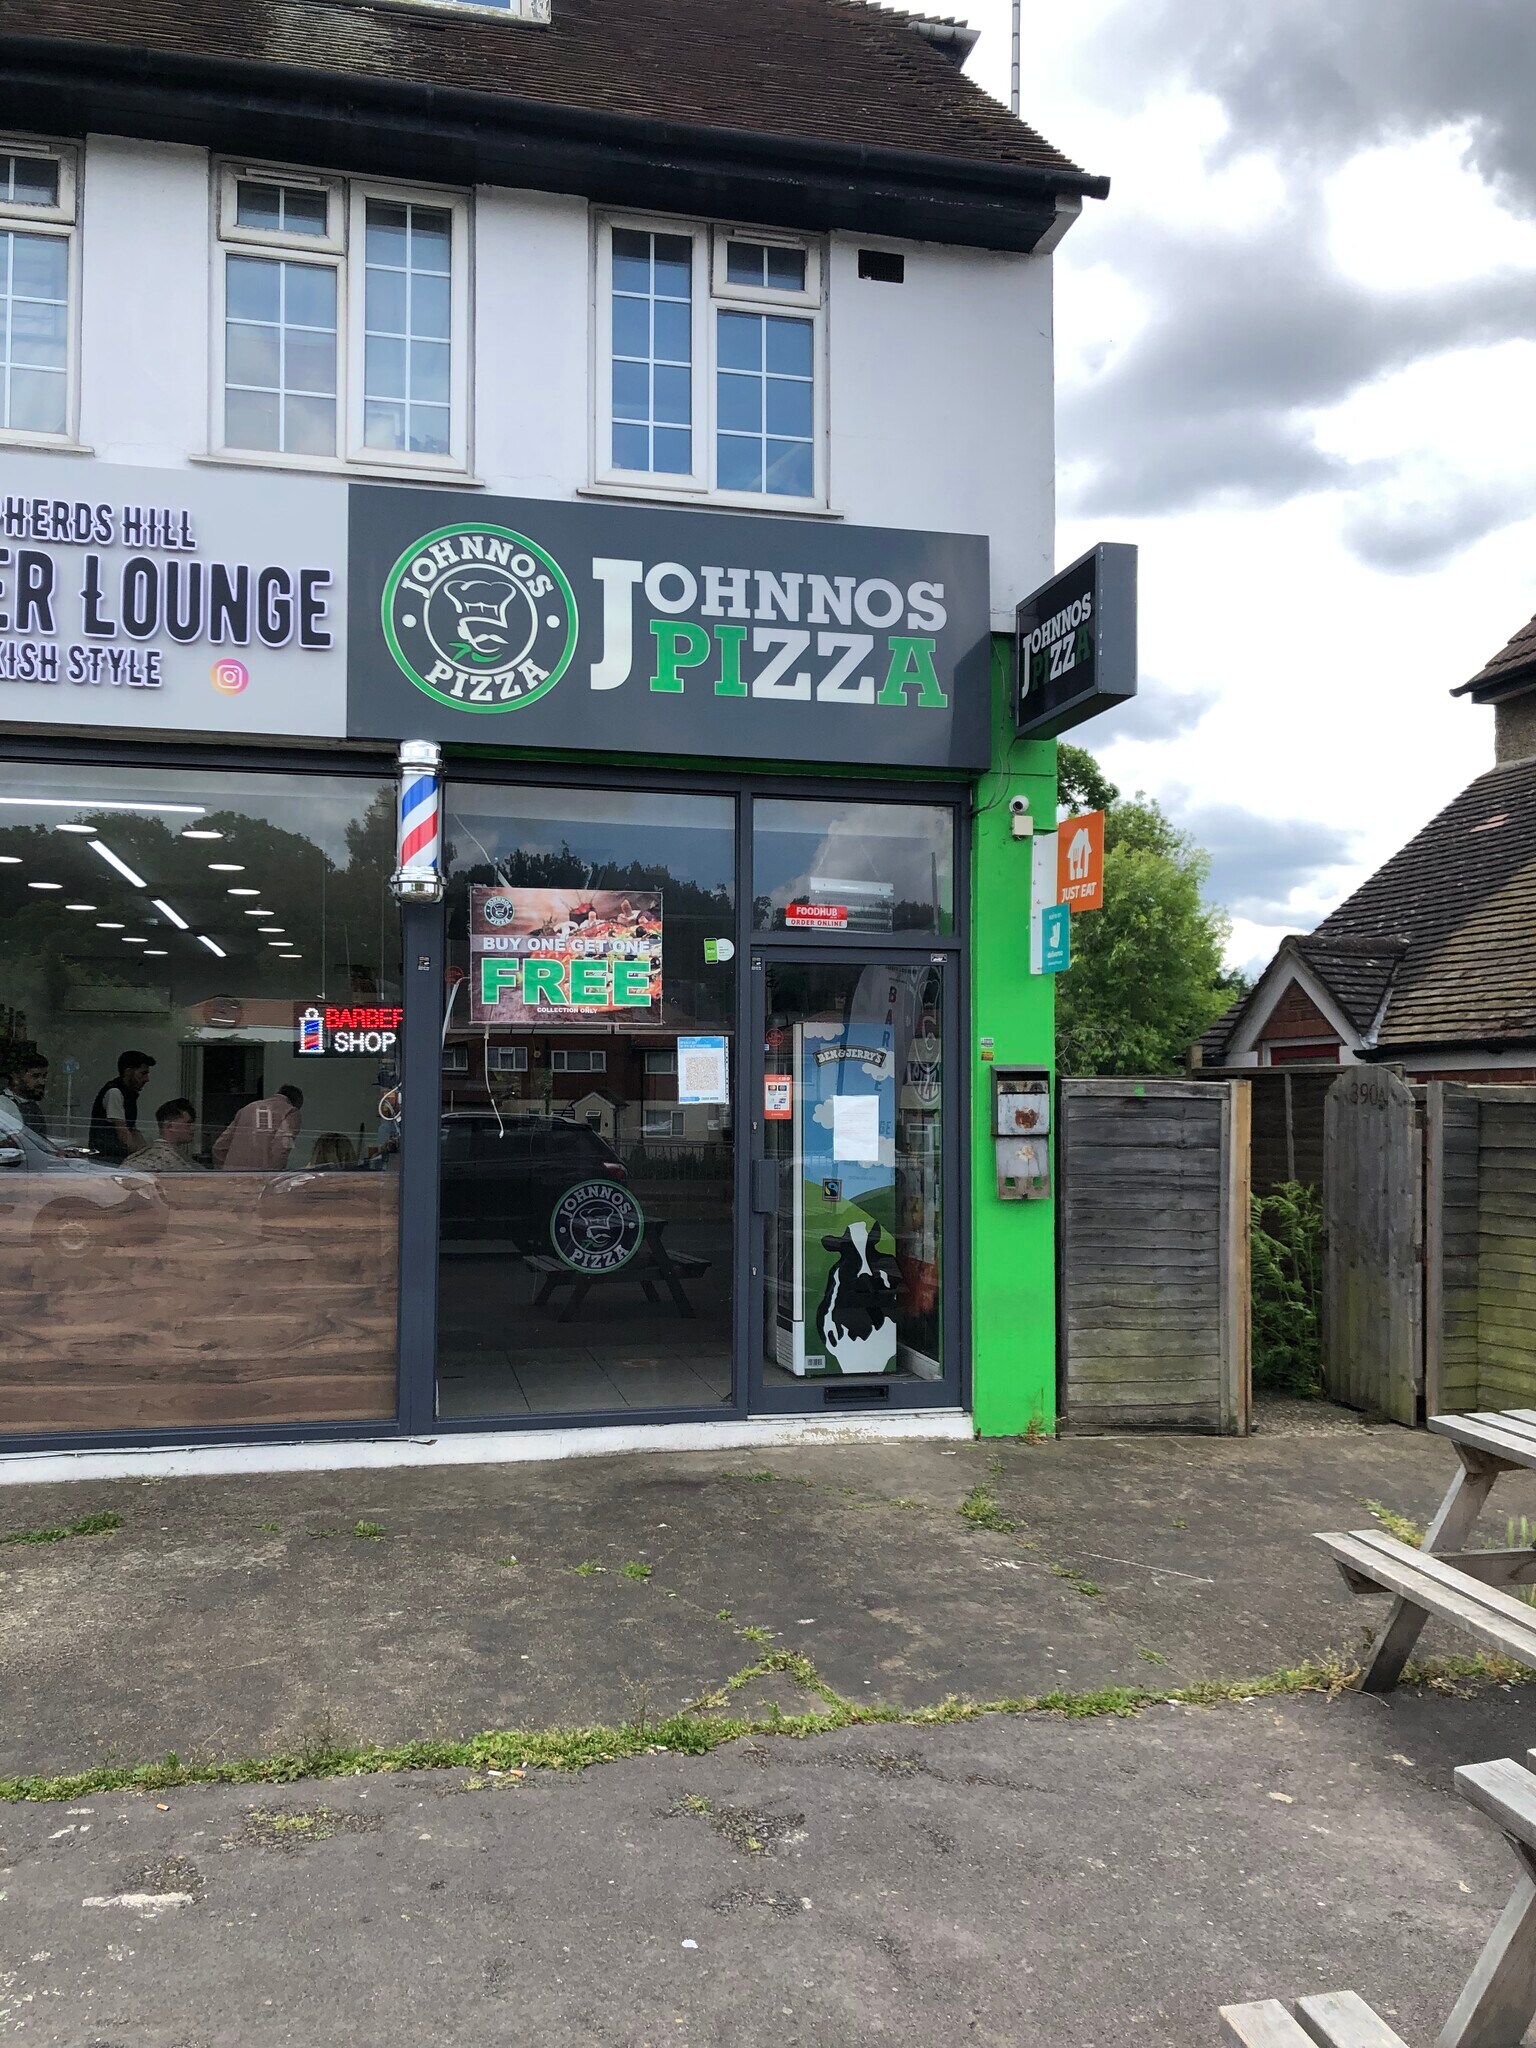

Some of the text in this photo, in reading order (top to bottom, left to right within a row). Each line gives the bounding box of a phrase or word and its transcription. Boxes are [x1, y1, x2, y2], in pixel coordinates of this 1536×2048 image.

[121, 506, 197, 549] HILL
[401, 535, 554, 599] JOHNNOS
[80, 554, 334, 648] LOUNGE
[590, 556, 948, 690] JOHNNOS
[67, 645, 162, 687] STYLE
[649, 618, 949, 708] PIZZA
[1022, 591, 1091, 699] JOHNNOS
[1032, 622, 1090, 692] PIZZA
[424, 658, 550, 701] PIZZA
[796, 906, 838, 916] FOODHUB
[1061, 882, 1097, 903] JUST EAT
[483, 937, 650, 954] BUY ONE GET ONE
[481, 957, 652, 1007] FREE
[537, 1006, 579, 1014] COLLECTION
[334, 1031, 397, 1053] SHOP
[560, 1185, 632, 1218] JOHNNOS
[569, 1244, 630, 1268] PIZZA
